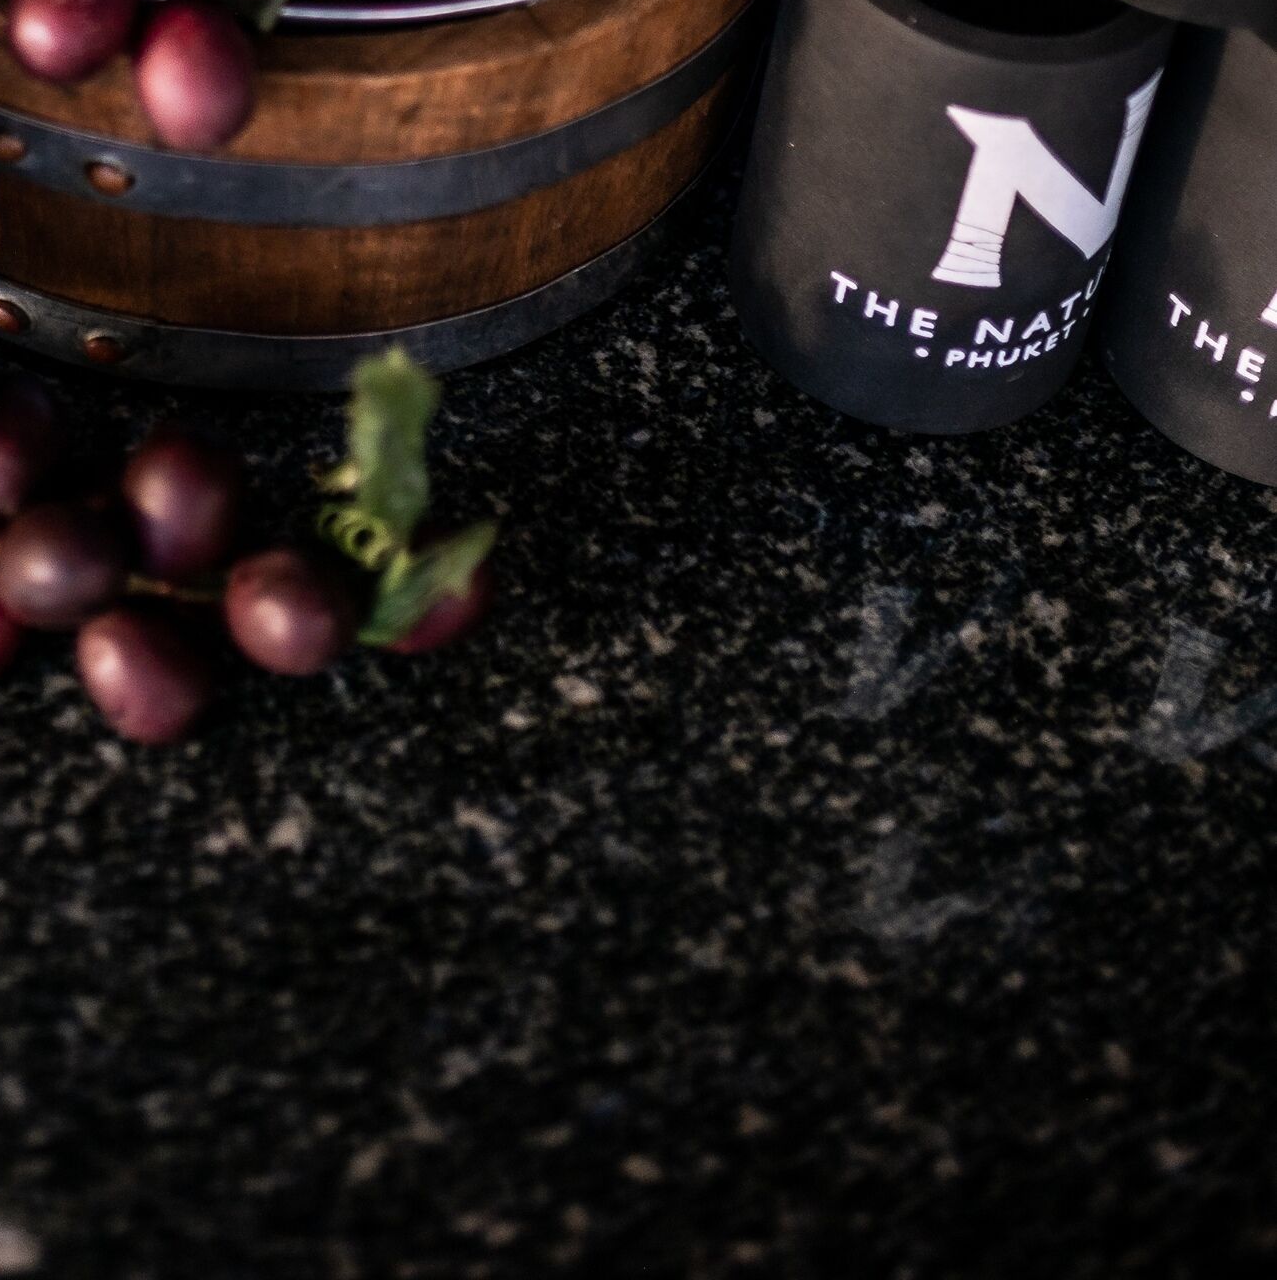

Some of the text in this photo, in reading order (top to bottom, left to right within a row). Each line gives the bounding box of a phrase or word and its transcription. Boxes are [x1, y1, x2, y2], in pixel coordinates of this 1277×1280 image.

[931, 67, 1164, 288] N
[831, 248, 1111, 345] THE NATU
[1169, 292, 1265, 382] THE
[945, 320, 1077, 369] PHUKET
